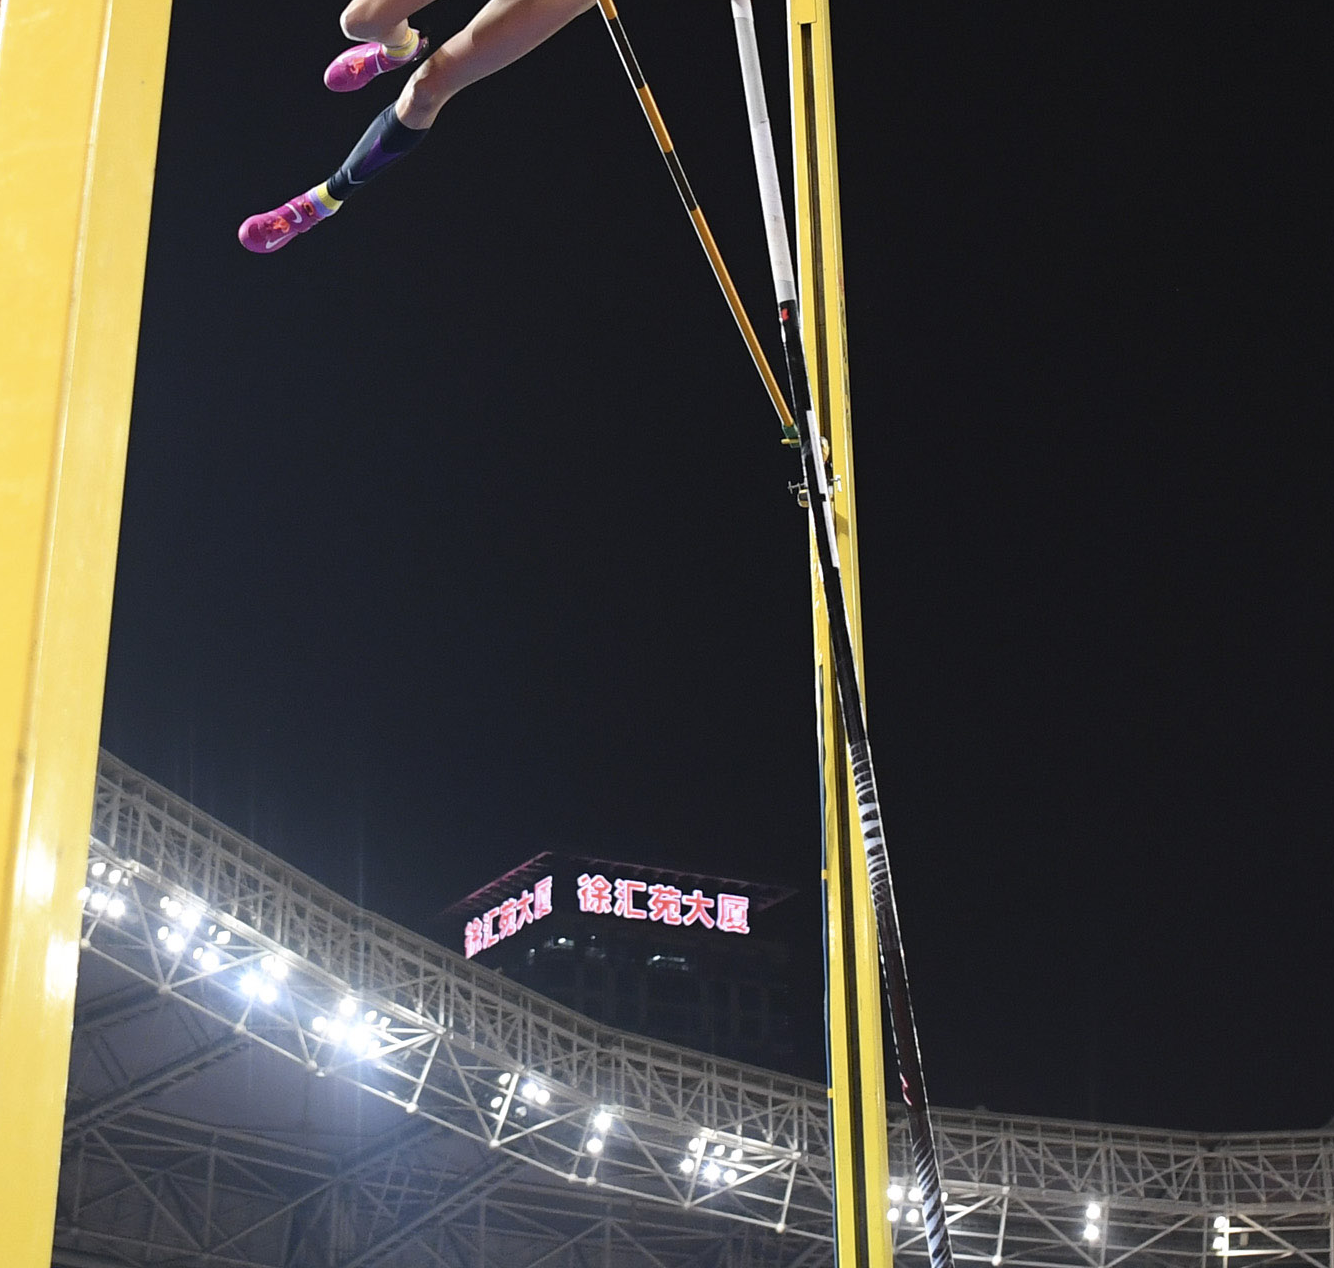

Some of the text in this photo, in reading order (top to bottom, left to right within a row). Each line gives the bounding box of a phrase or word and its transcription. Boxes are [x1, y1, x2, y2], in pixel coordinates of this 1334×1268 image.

[464, 875, 553, 960] 徐汇苑大厦
[576, 873, 750, 934] 徐汇苑大厦
